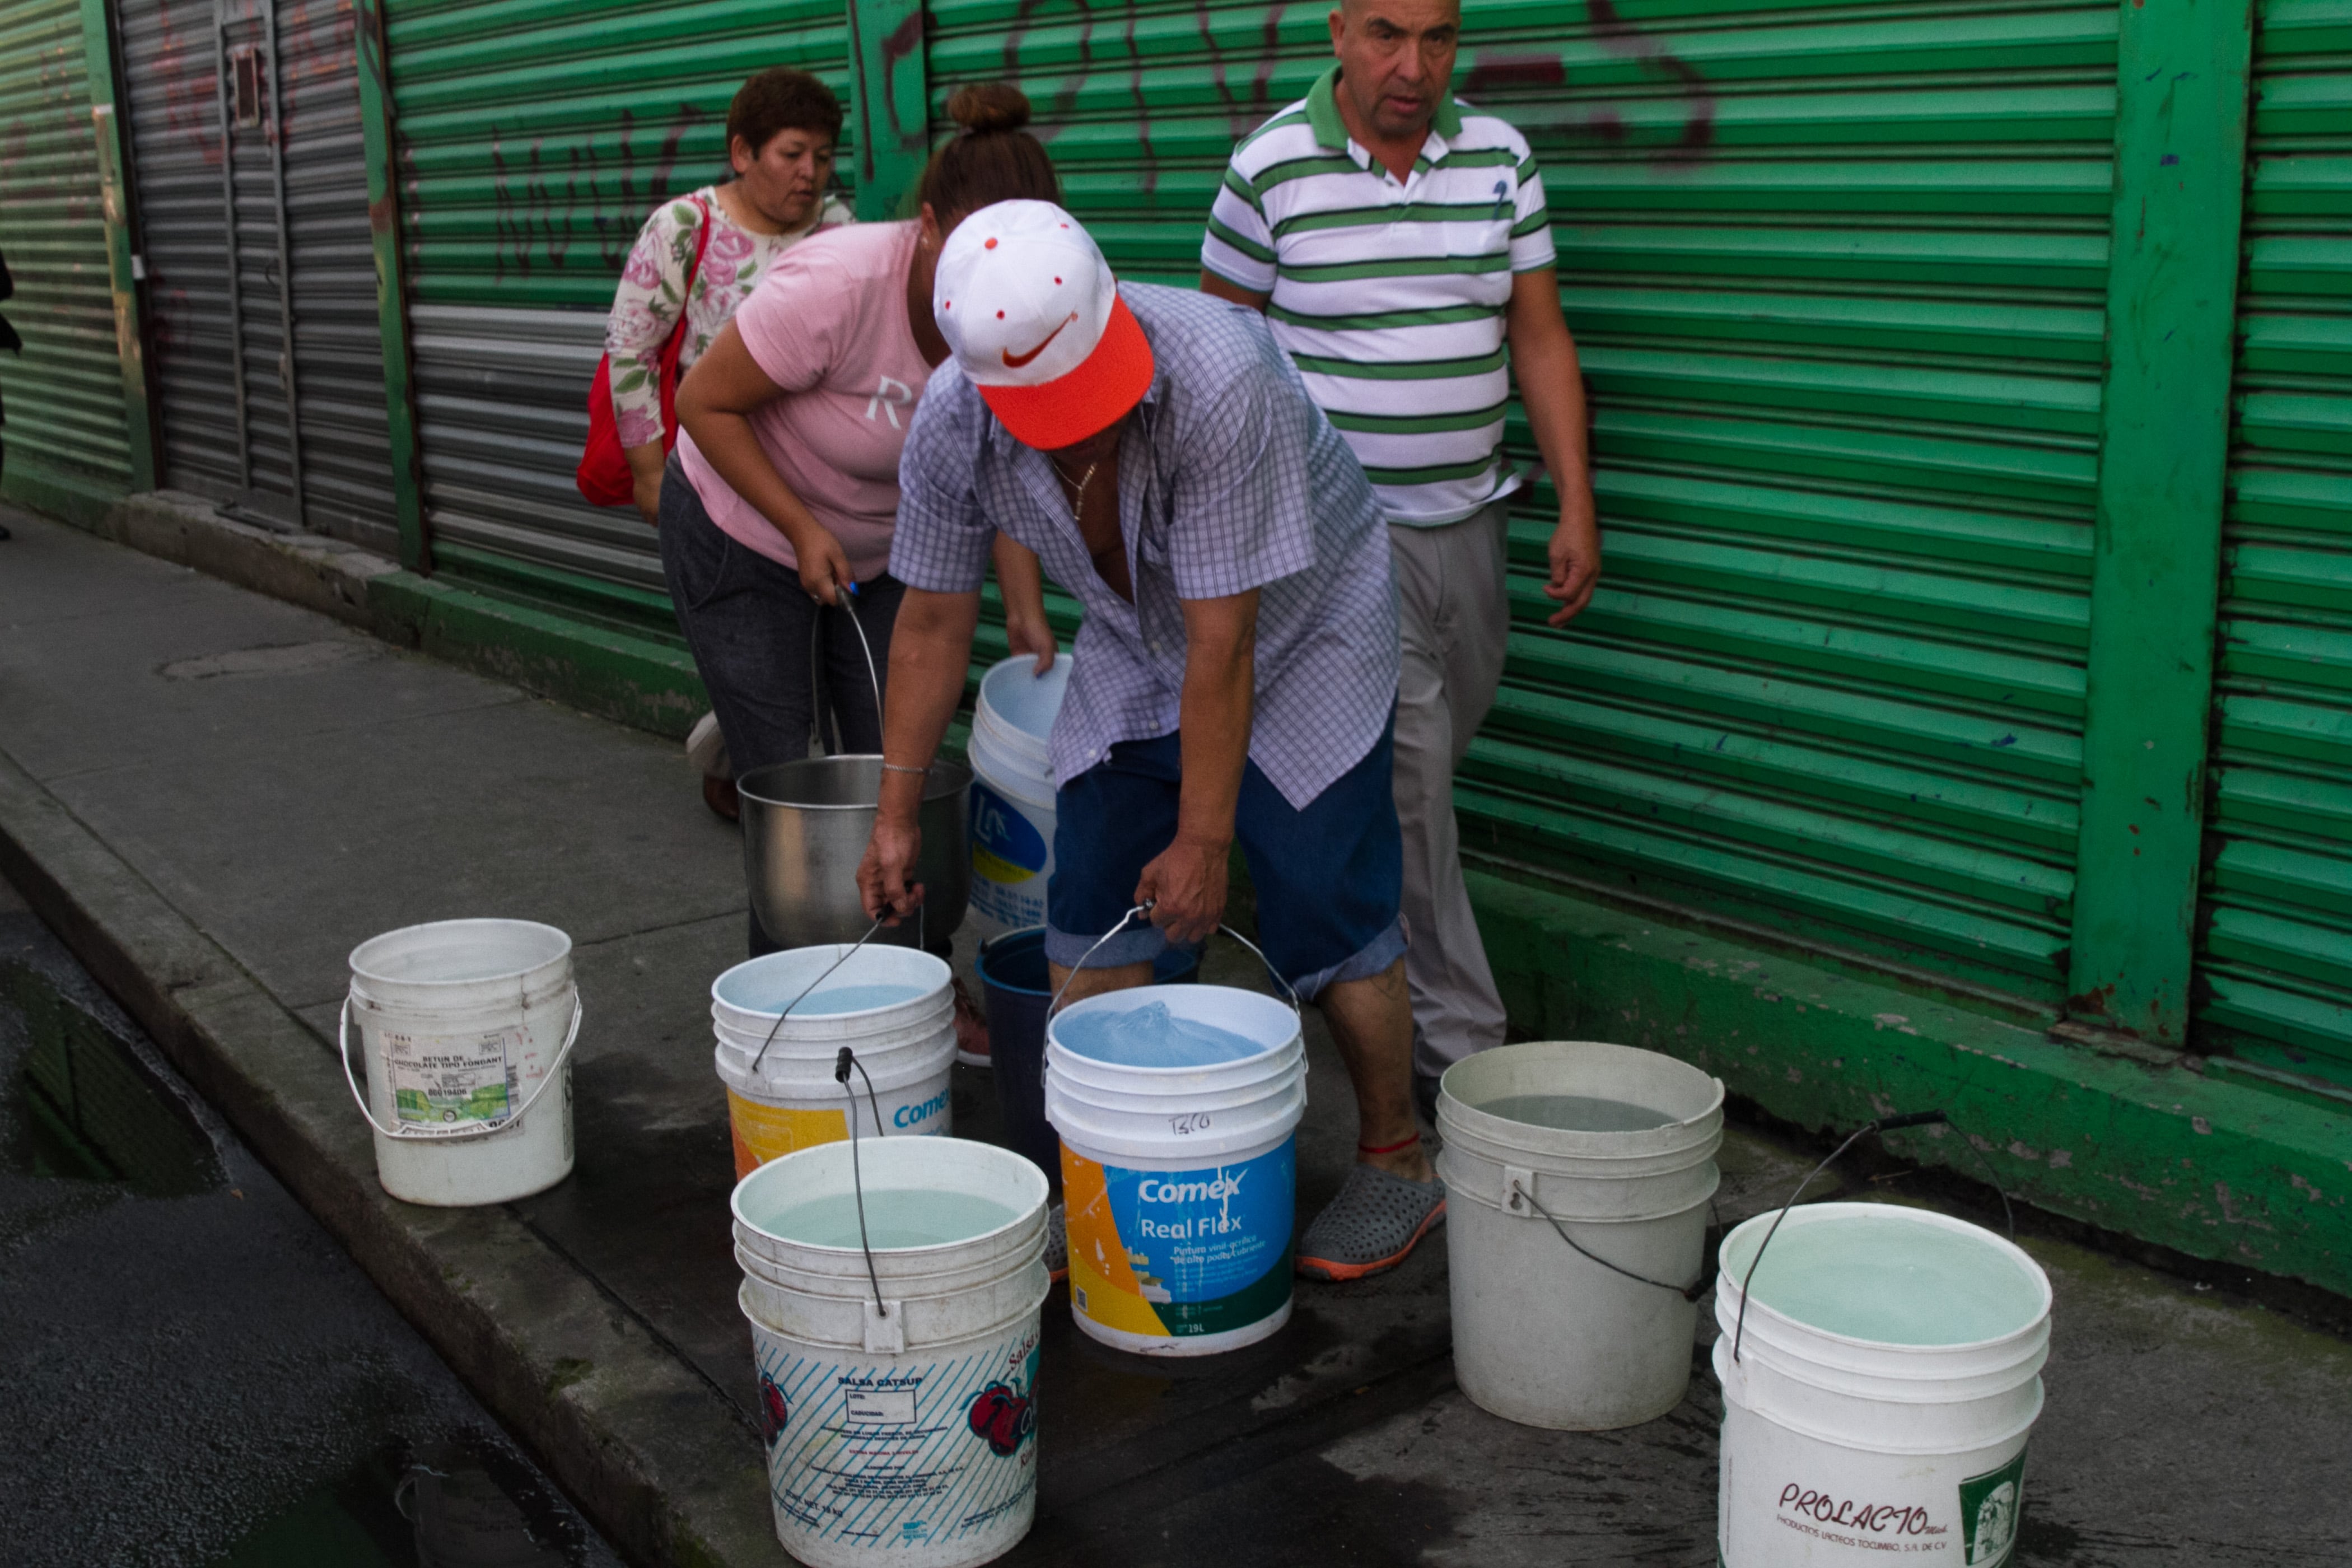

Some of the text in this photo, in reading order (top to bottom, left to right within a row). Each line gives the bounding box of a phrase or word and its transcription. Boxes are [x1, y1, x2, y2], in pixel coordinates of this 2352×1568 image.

[394, 1060, 437, 1068] CHOCOLATE
[463, 1056, 502, 1066] FONDANT
[1138, 1168, 1249, 1204] Comex
[1141, 1216, 1242, 1239] Real Flex
[1173, 1246, 1206, 1255] Pintura
[1187, 1255, 1204, 1264] alto
[838, 1376, 923, 1387] SALSA CATSUP
[1779, 1482, 1928, 1535] PROLACTO
[1777, 1514, 1819, 1537] PRODUCTOS
